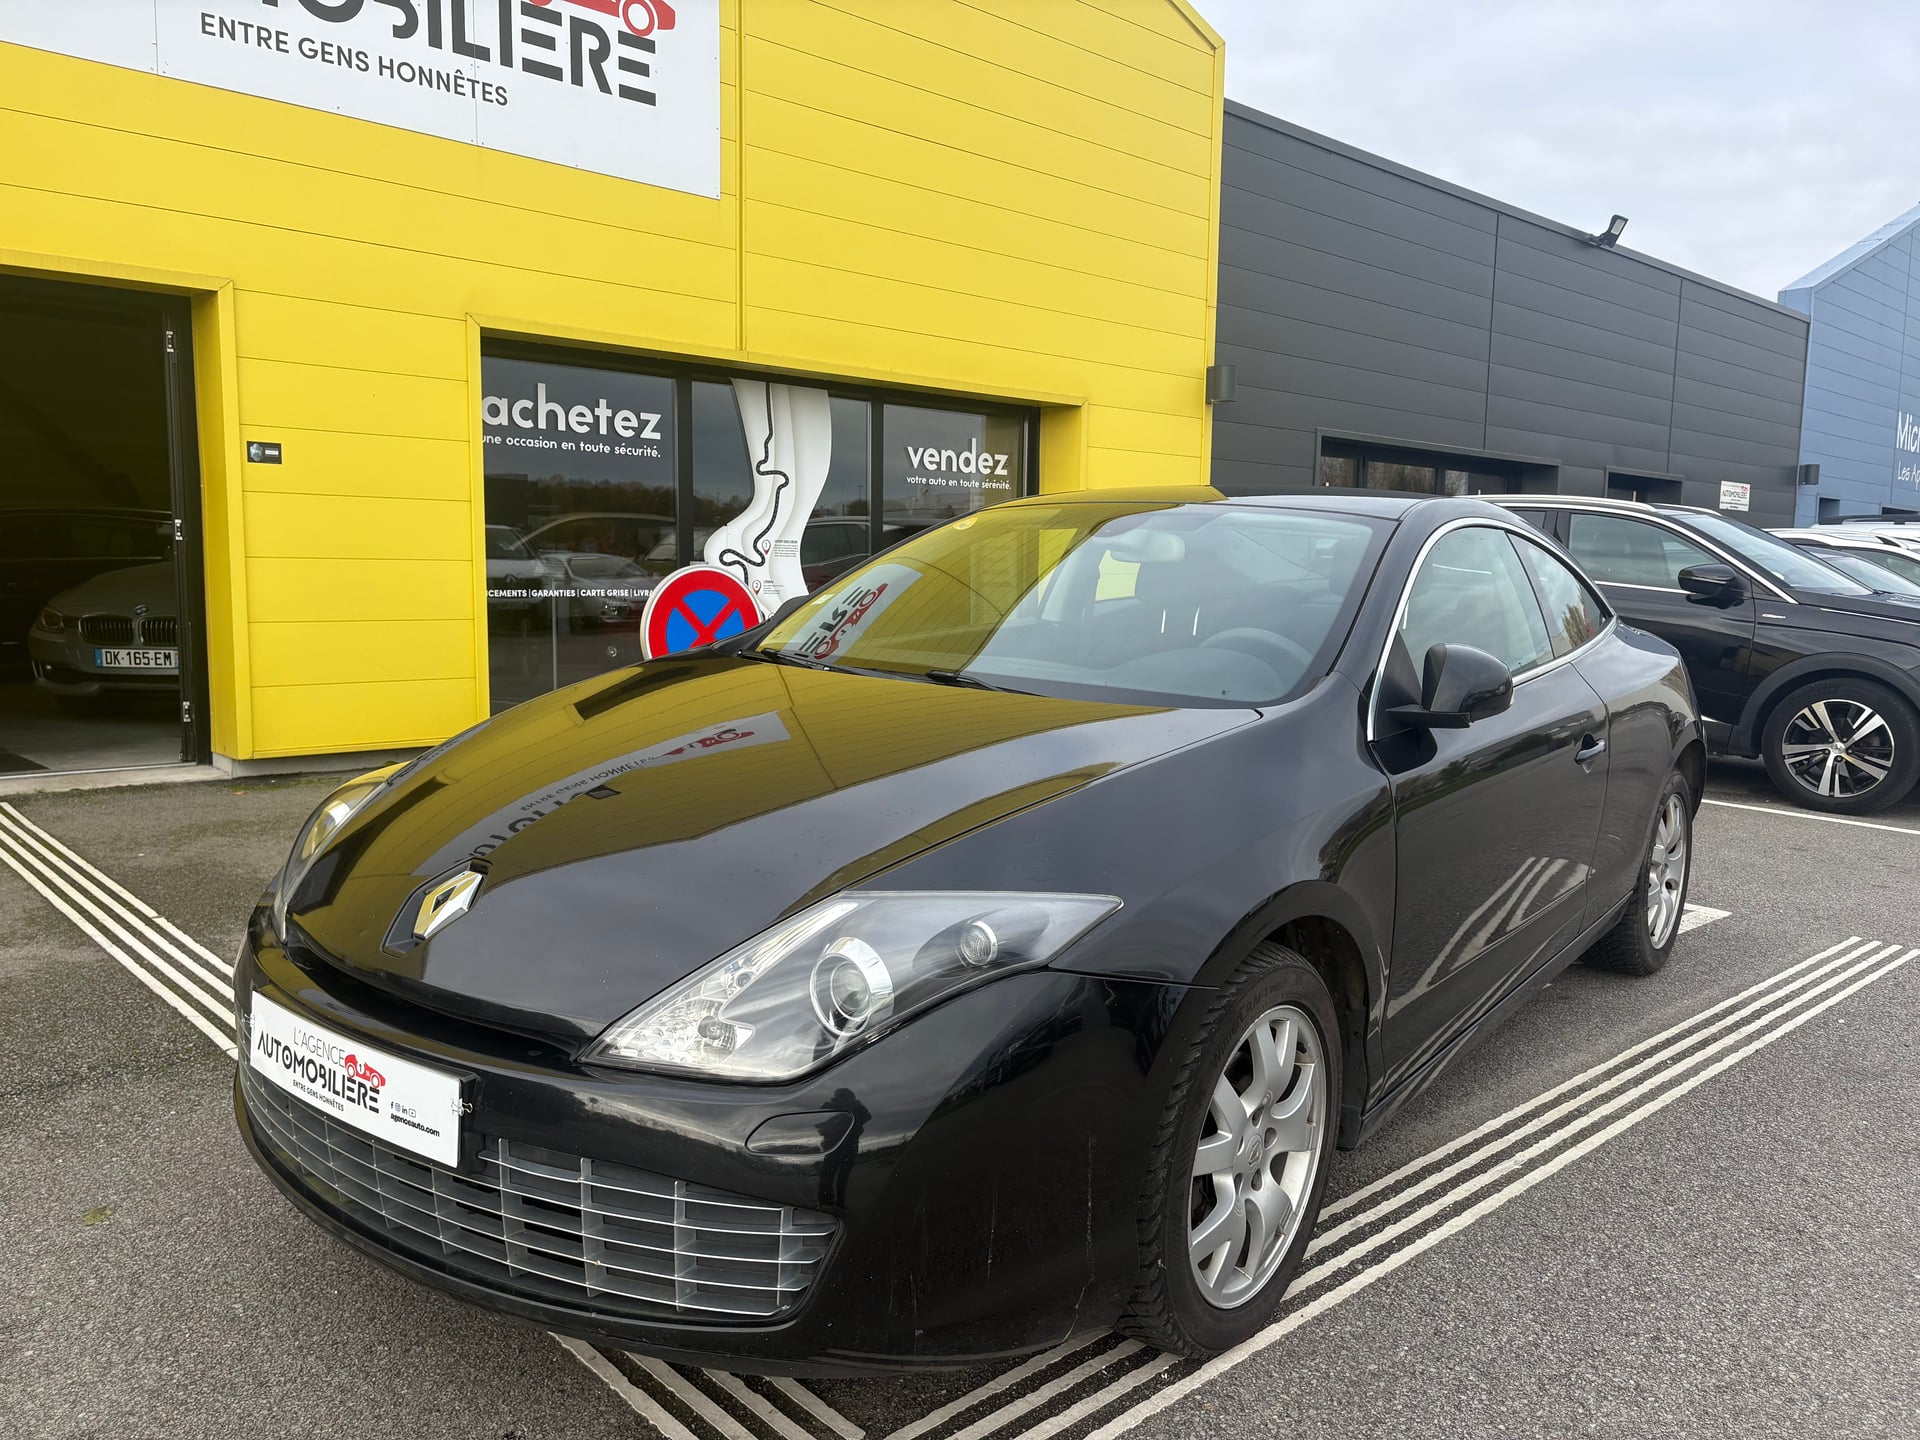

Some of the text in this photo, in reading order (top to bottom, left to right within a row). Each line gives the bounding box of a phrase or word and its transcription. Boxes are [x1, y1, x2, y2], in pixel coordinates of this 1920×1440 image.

[201, 12, 508, 106] ENTRE GENS HONNÊTES
[262, 0, 656, 106] ILIERE
[482, 383, 661, 440] achetez
[506, 436, 557, 449] occasion
[561, 441, 575, 451] en
[579, 441, 610, 454] toute
[614, 443, 661, 458] sécurité.
[907, 438, 1008, 475] vendez
[906, 475, 1011, 490] votre auto en toute sérénité.
[486, 589, 527, 598] CEMENTS
[531, 589, 576, 598] GARANTIES
[580, 589, 605, 597] CARTE
[607, 589, 629, 597] GRISE
[105, 651, 172, 666] DK-165-EM
[293, 1027, 345, 1068] L'AGENCE
[293, 1080, 345, 1112] ENTRE GENS HONNÊTES
[391, 1113, 440, 1137] agenceauto.com
